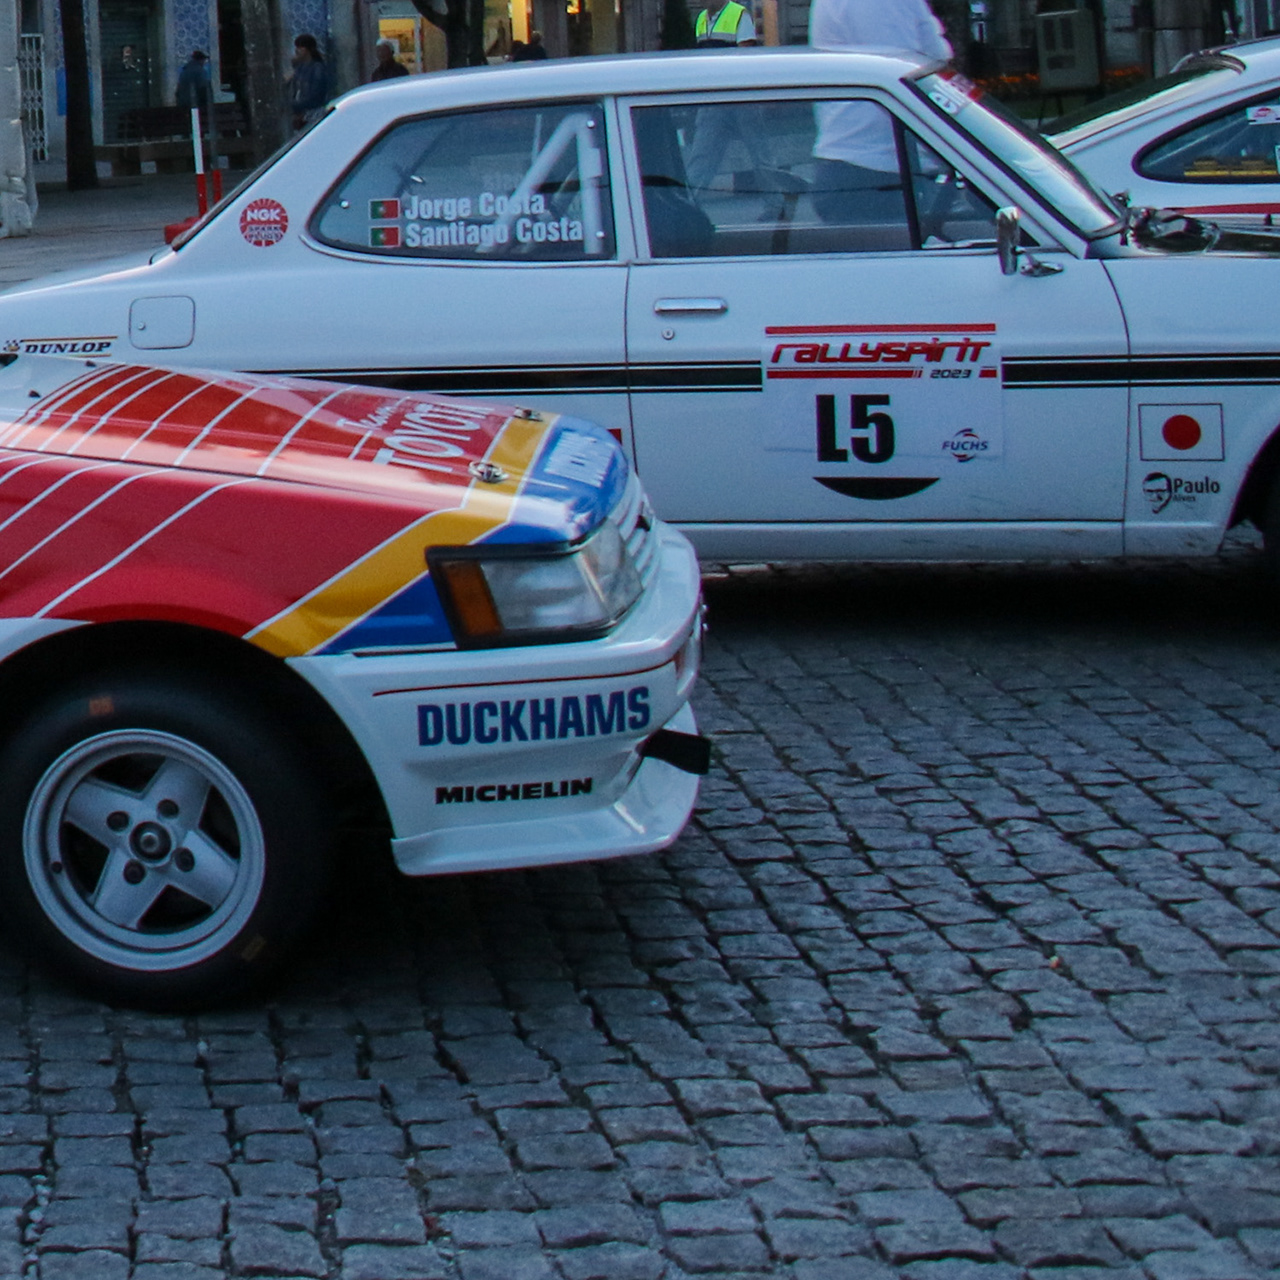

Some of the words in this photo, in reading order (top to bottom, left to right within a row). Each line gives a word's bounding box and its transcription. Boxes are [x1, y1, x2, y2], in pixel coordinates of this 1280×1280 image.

[247, 208, 281, 221] NGK
[405, 195, 471, 221] Jorge
[479, 192, 545, 216] Costa
[405, 221, 509, 247] Santiago
[516, 216, 583, 242] Costa
[25, 342, 111, 354] DUNLOP
[930, 369, 972, 378] 2023
[816, 394, 895, 463] L5
[942, 440, 988, 451] FUCHS
[1173, 476, 1220, 493] Paulo
[417, 686, 651, 746] DUCKHAMS
[435, 777, 593, 805] MICHELIN
